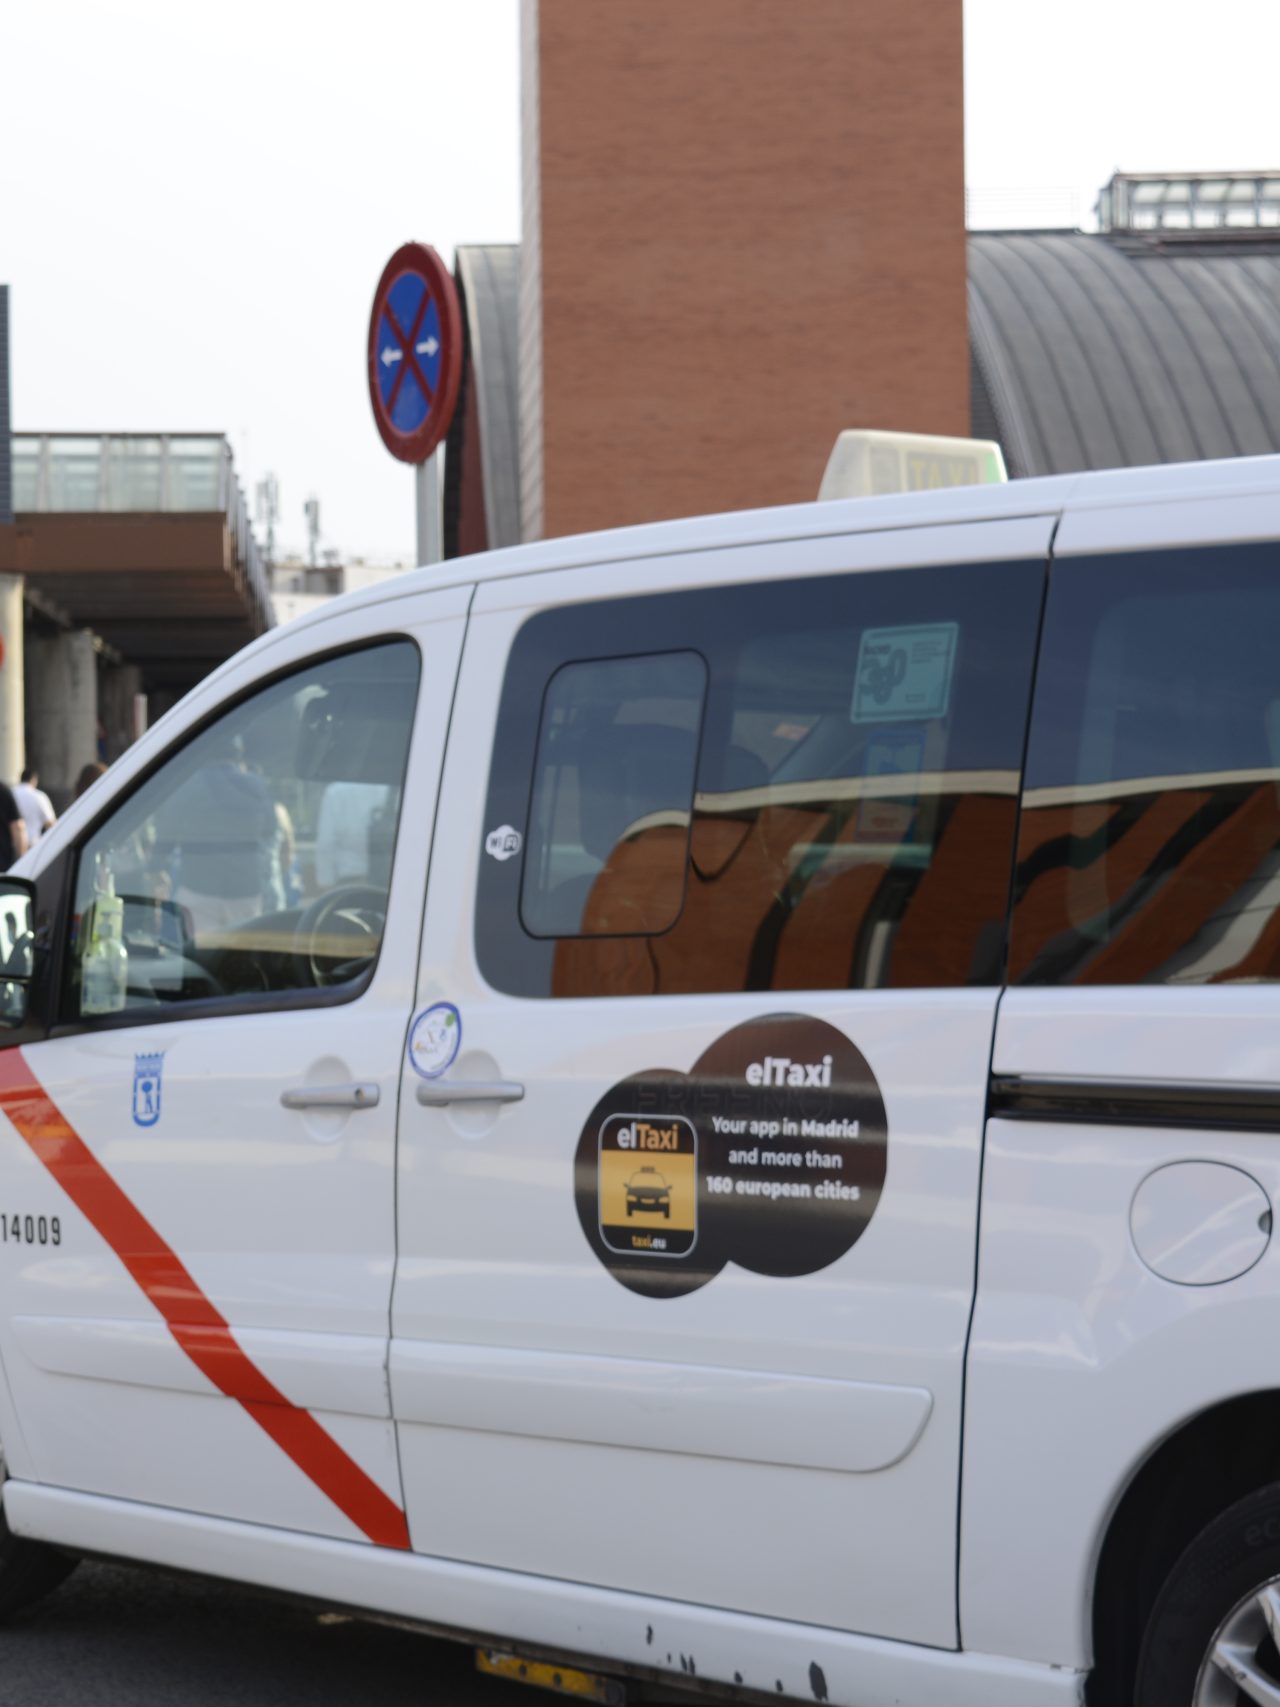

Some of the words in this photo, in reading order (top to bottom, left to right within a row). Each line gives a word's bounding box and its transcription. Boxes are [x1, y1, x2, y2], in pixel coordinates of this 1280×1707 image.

[745, 1056, 833, 1089] elTaxi
[617, 1122, 679, 1150] elTaxi
[712, 1117, 747, 1134] Your
[749, 1120, 780, 1139] app
[782, 1117, 798, 1136] in
[800, 1119, 859, 1139] Madrid
[728, 1148, 758, 1165] and
[761, 1151, 803, 1167] more
[805, 1150, 843, 1169] than
[706, 1176, 733, 1194] 160
[735, 1180, 812, 1200] european
[814, 1180, 860, 1201] cities
[1, 1213, 61, 1246] 14009
[632, 1235, 667, 1249] taxi.eu
